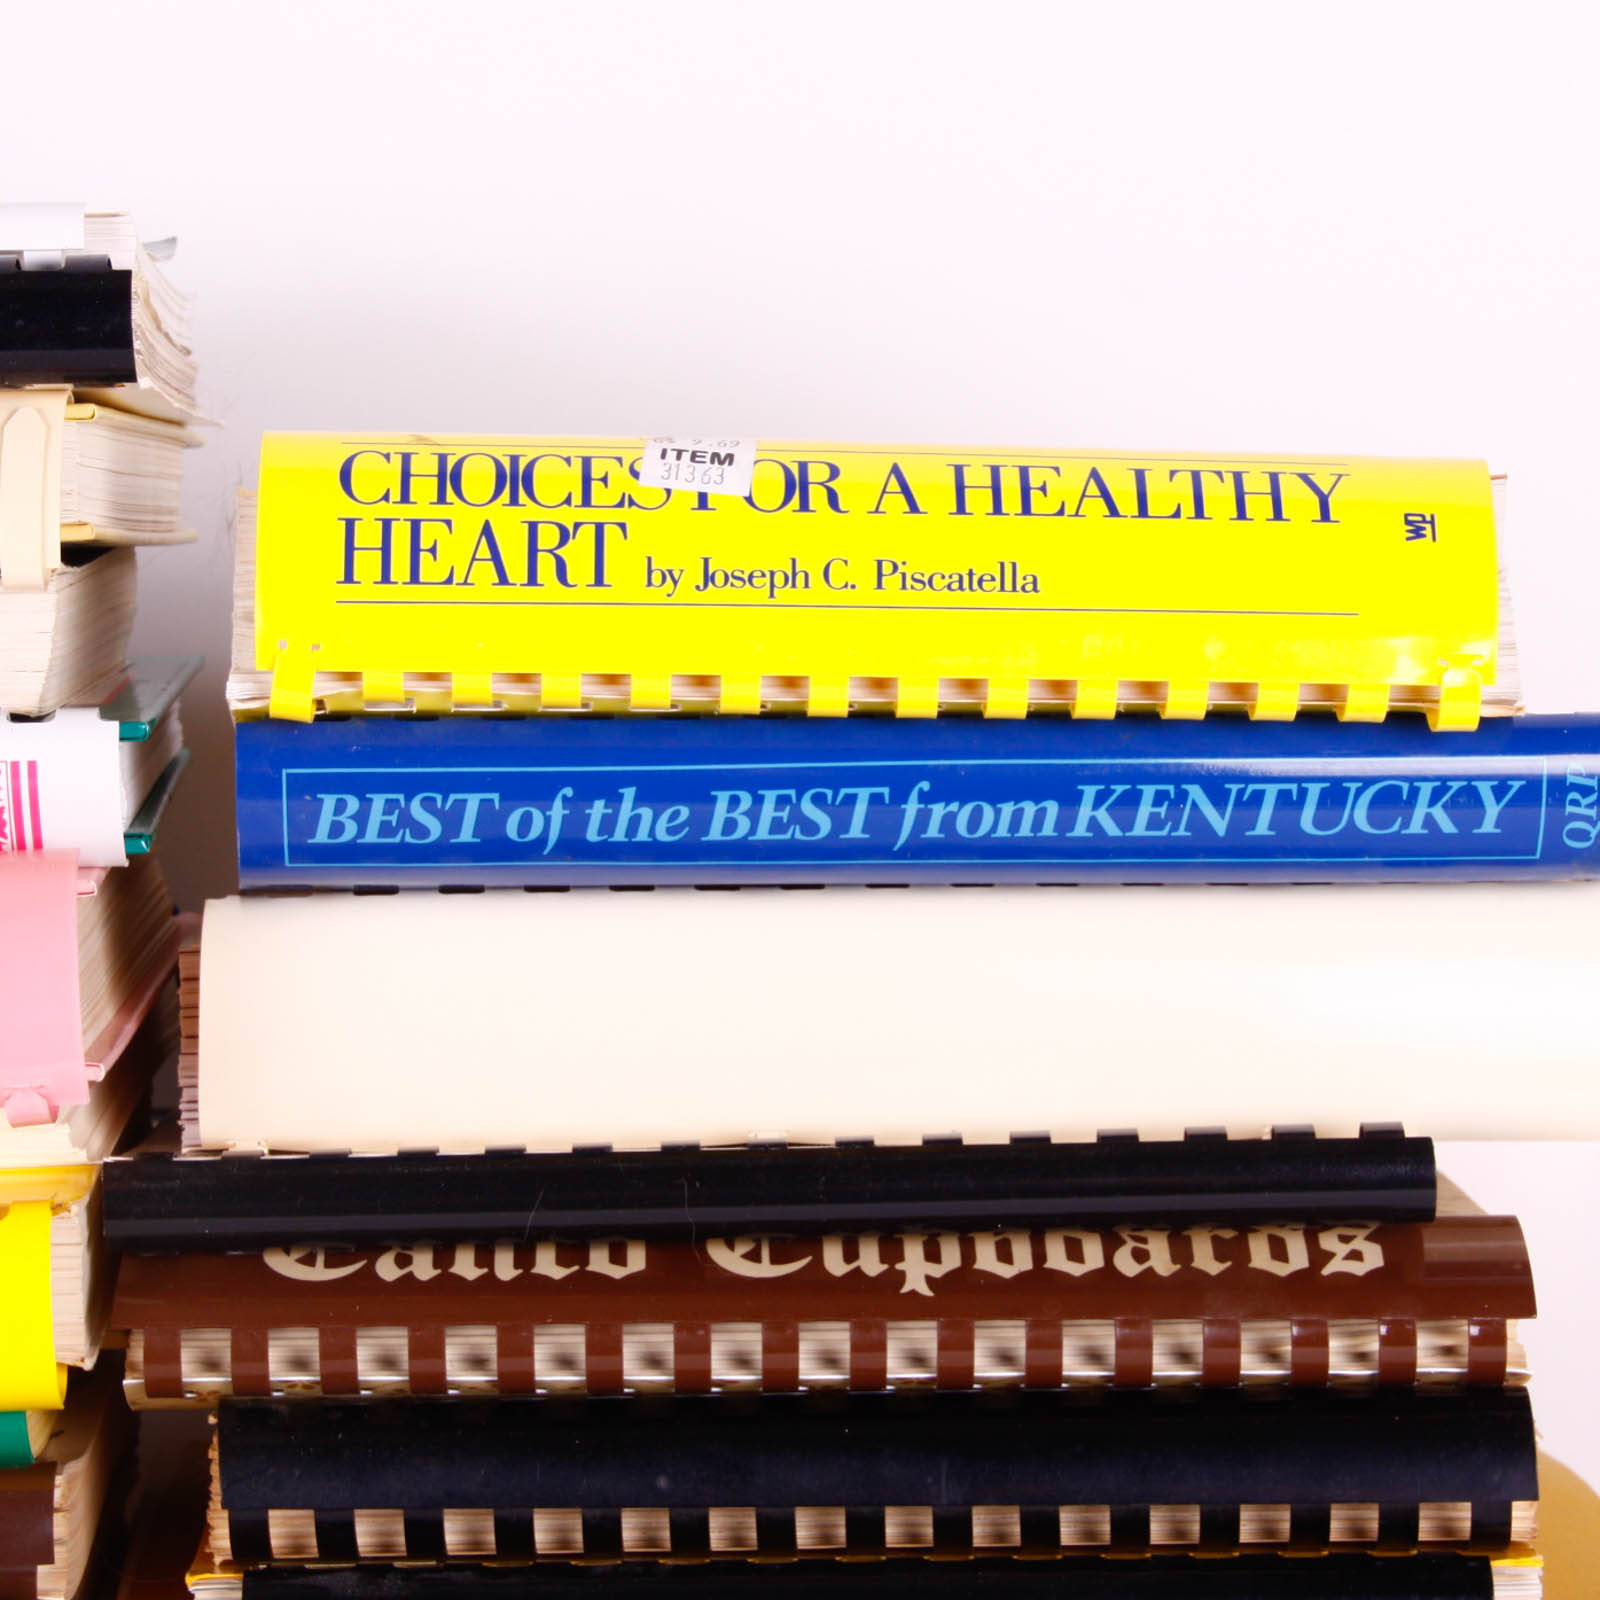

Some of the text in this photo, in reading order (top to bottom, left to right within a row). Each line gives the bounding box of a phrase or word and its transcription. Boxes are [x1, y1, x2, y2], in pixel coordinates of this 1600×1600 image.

[340, 449, 672, 510] CHOICES
[867, 463, 927, 514] A
[948, 463, 1350, 523] HEALTHY
[660, 448, 735, 466] ITEM
[336, 518, 1040, 598] HEART by Joseph C. Piscatella
[308, 781, 1525, 854] BEST of the BEST from KENTUCKY
